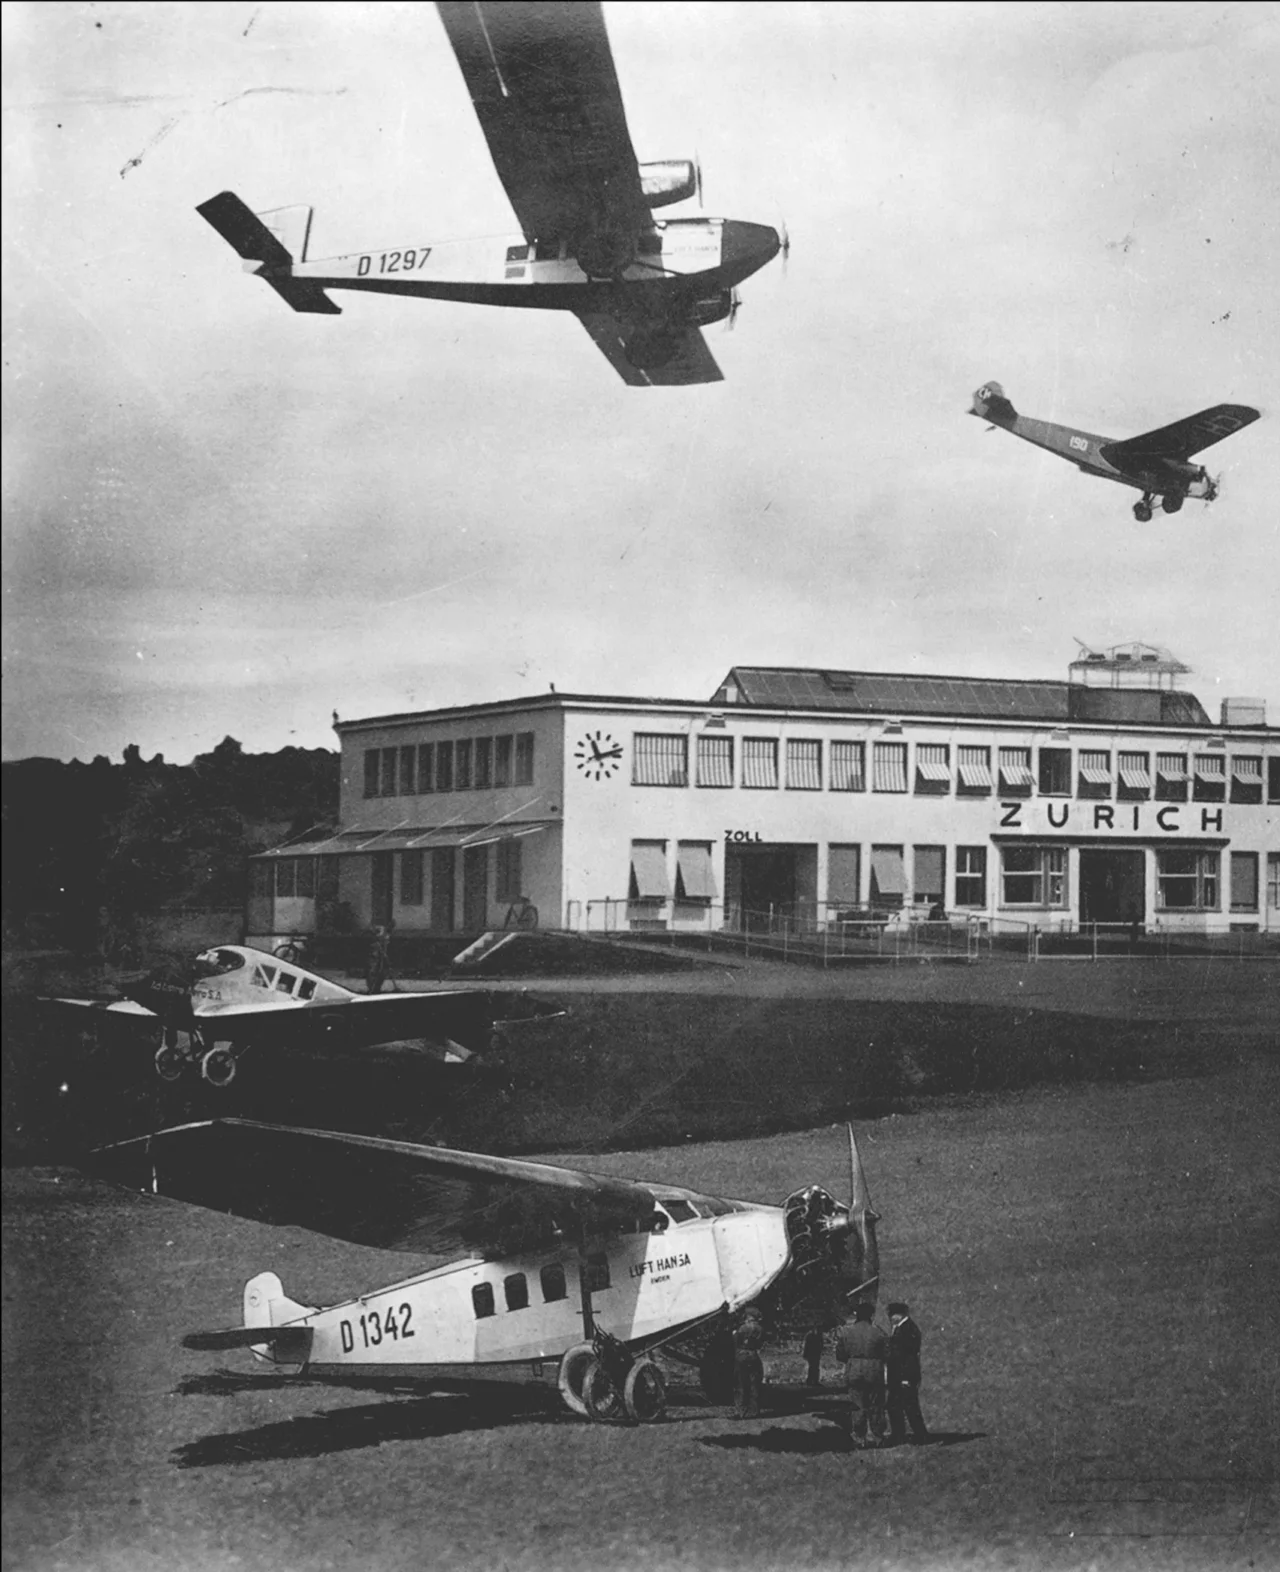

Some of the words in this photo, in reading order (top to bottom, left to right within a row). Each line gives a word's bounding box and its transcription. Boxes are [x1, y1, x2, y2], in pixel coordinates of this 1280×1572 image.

[357, 256, 371, 276] D
[380, 248, 432, 273] 1297
[1069, 435, 1089, 452] 190
[1000, 802, 1223, 832] ZURICH
[724, 829, 763, 842] ZOLL
[629, 1260, 653, 1278] LUFT
[656, 1253, 691, 1271] HANSA
[340, 1320, 354, 1353] D
[360, 1302, 415, 1348] 1342
